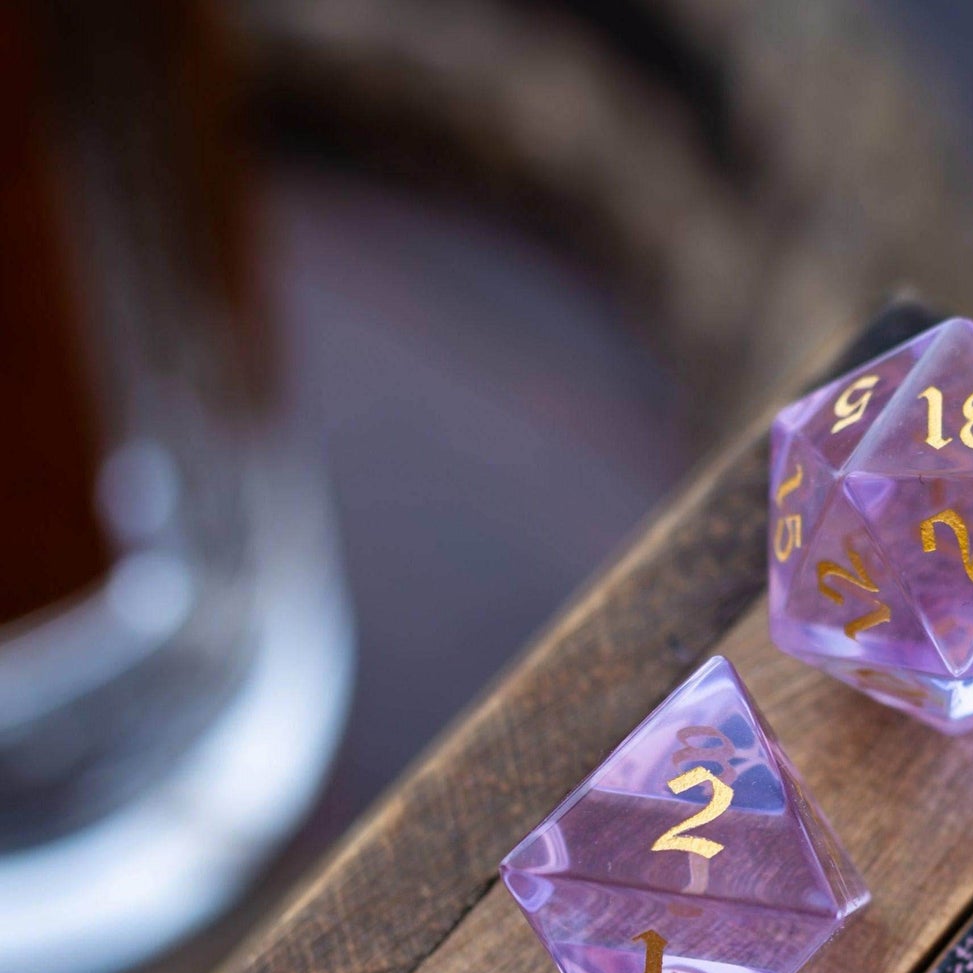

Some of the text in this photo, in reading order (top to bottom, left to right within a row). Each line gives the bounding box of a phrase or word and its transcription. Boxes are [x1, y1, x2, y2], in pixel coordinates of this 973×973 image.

[831, 375, 880, 435] 5
[774, 464, 803, 563] 15
[650, 766, 735, 859] 2
